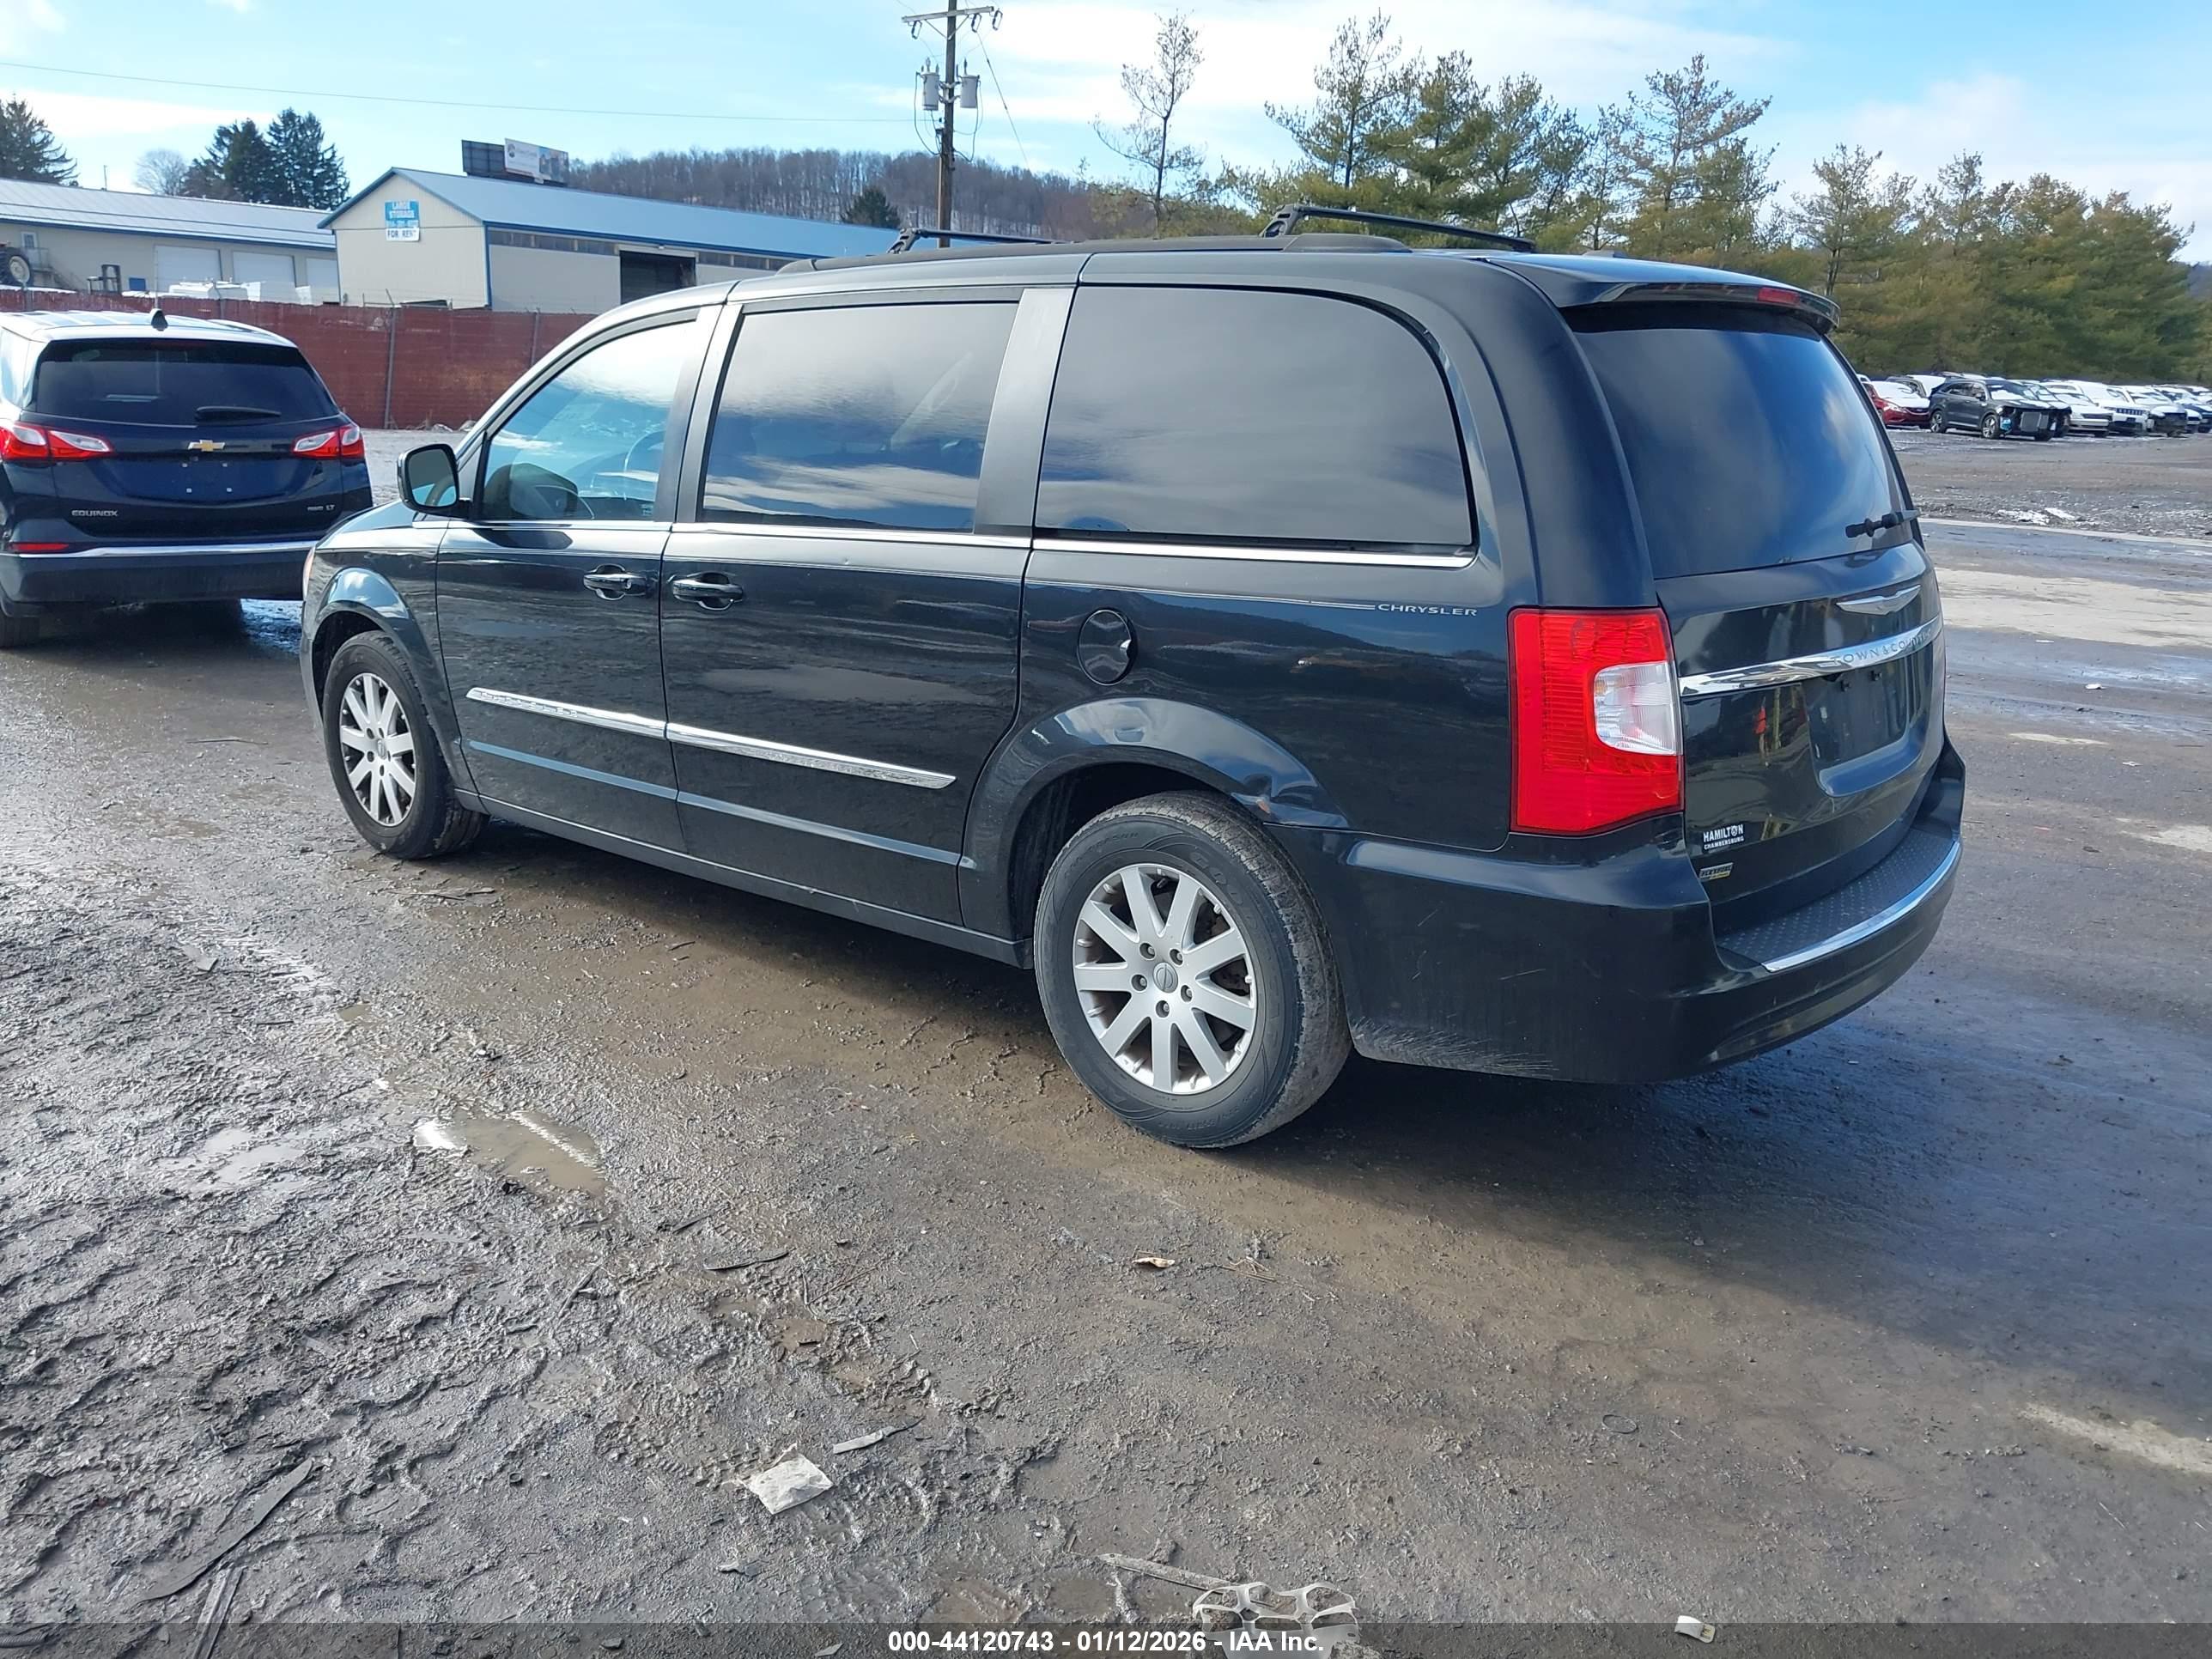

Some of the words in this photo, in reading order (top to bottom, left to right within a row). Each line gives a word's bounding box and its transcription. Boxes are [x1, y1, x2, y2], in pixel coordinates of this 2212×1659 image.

[386, 229, 399, 239] FOR
[1377, 604, 1478, 617] CHRYSLER
[1703, 823, 1744, 843] HAMILTON
[1704, 836, 1745, 850] CHAMBERSBURG
